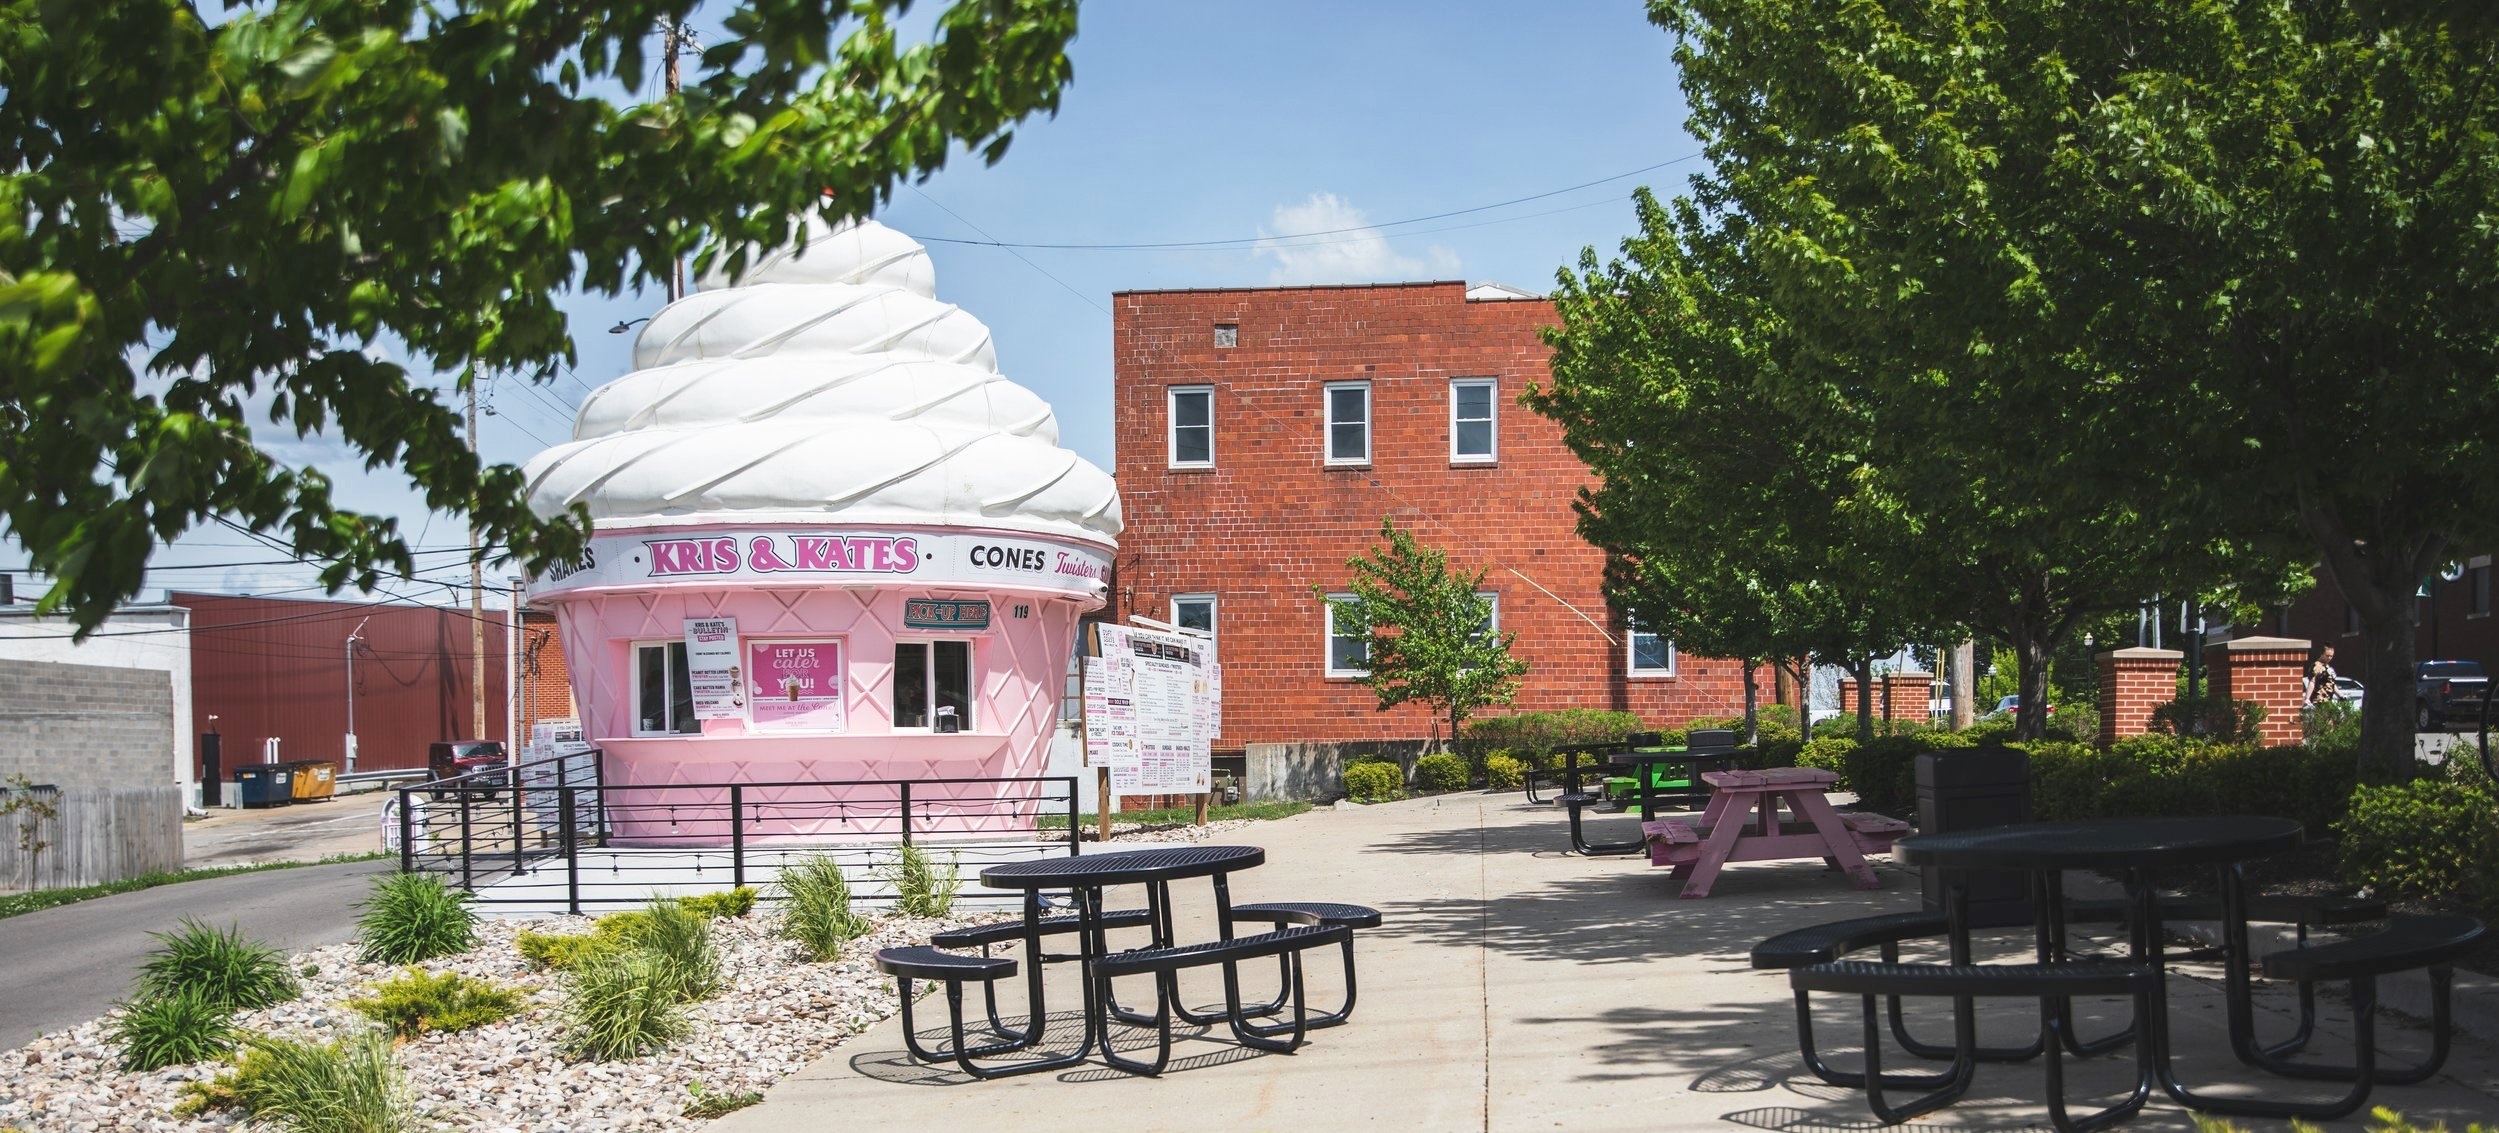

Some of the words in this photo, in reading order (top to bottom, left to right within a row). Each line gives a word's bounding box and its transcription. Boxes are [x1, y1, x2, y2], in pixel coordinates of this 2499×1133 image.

[643, 537, 741, 576] KRIS
[749, 536, 796, 573] &
[791, 536, 919, 574] KATES
[970, 545, 1046, 573] CONES
[1055, 552, 1097, 578] Twisters
[908, 602, 957, 621] PICK-UP
[957, 604, 988, 621] HERE
[1014, 605, 1029, 619] 119
[692, 627, 729, 635] BULLETIN
[775, 648, 795, 658] LET
[799, 648, 816, 658] US
[772, 655, 821, 669] cater
[783, 669, 809, 678] FOR
[776, 678, 815, 689] YU!
